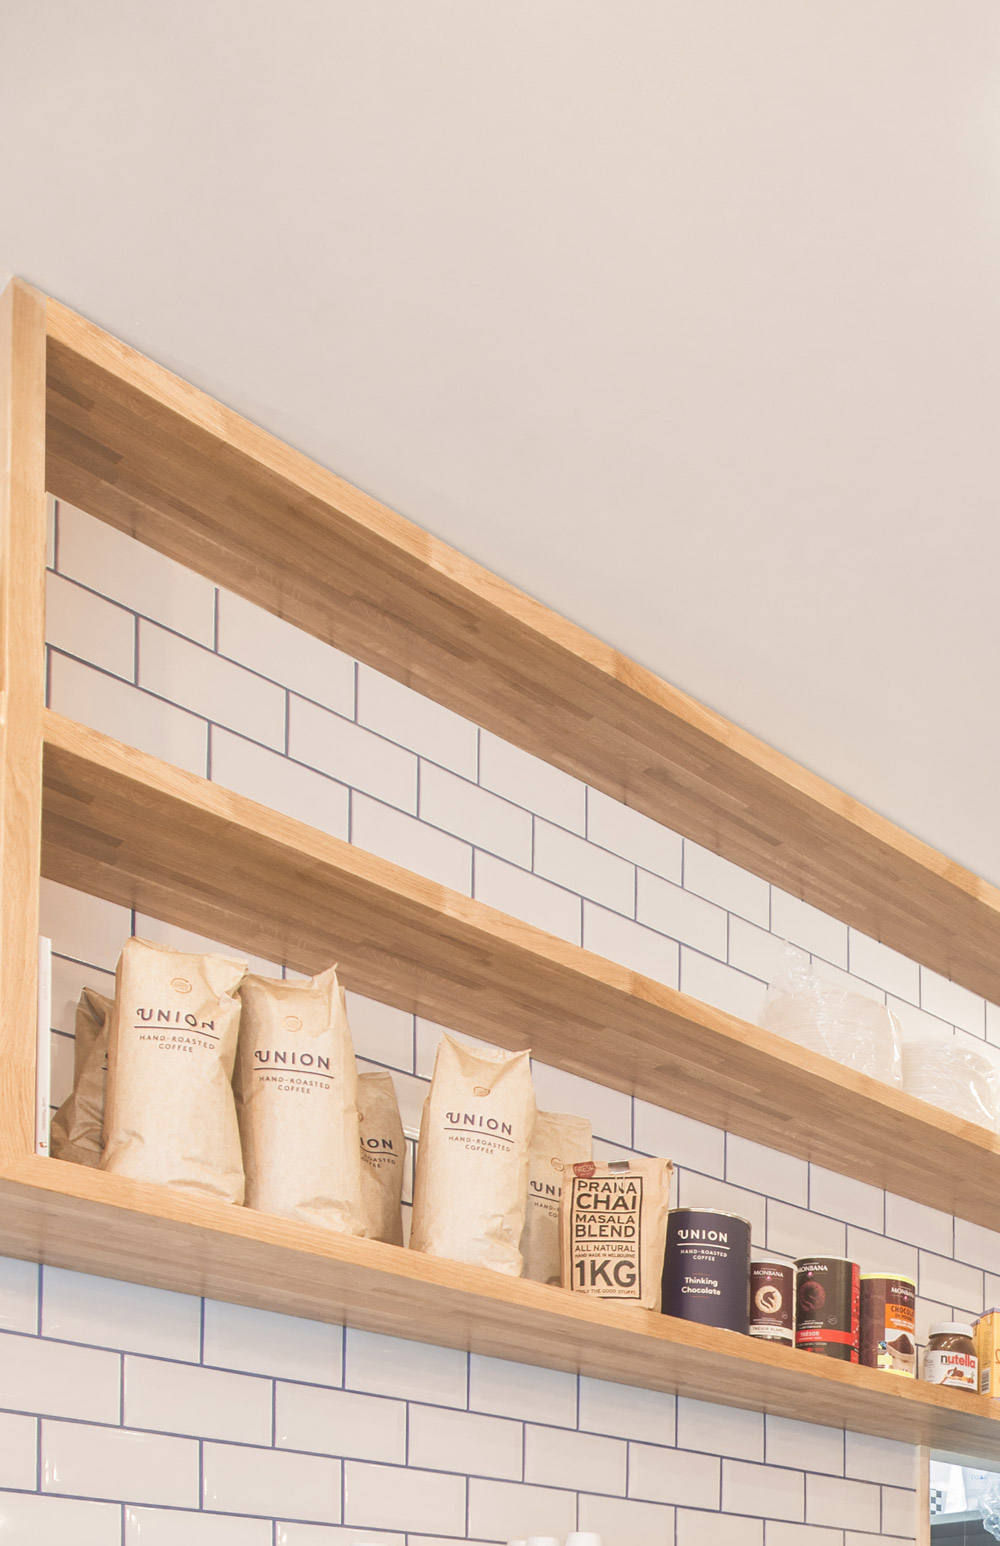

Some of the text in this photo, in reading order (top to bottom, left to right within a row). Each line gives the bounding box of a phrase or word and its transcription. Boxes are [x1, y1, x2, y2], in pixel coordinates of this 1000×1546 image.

[136, 1008, 216, 1030] UNION
[139, 1035, 215, 1050] HAND-ROASTED
[158, 1043, 193, 1053] COFFEE
[255, 1050, 330, 1070] UNION
[259, 1076, 330, 1090] HAND-ROASTED
[278, 1085, 311, 1094] COFFEE
[446, 1112, 513, 1135] UNION
[360, 1137, 393, 1150] ION
[448, 1136, 511, 1152] HAND-ROASTED
[465, 1144, 494, 1155] COFFEE
[530, 1180, 561, 1197] UNI
[577, 1180, 637, 1194] PRANA
[576, 1193, 637, 1210] CHAI
[575, 1213, 635, 1225] MASALA
[575, 1224, 636, 1238] BLEND
[677, 1229, 728, 1243] UNION
[575, 1244, 636, 1253] ALL NATURAL
[680, 1249, 728, 1258] HAND-ROASTED
[575, 1260, 636, 1287] 1KG
[753, 1270, 784, 1278] MONBANA
[684, 1277, 718, 1287] Thinking
[681, 1286, 721, 1296] Chocolate
[941, 1354, 976, 1369] nutella
